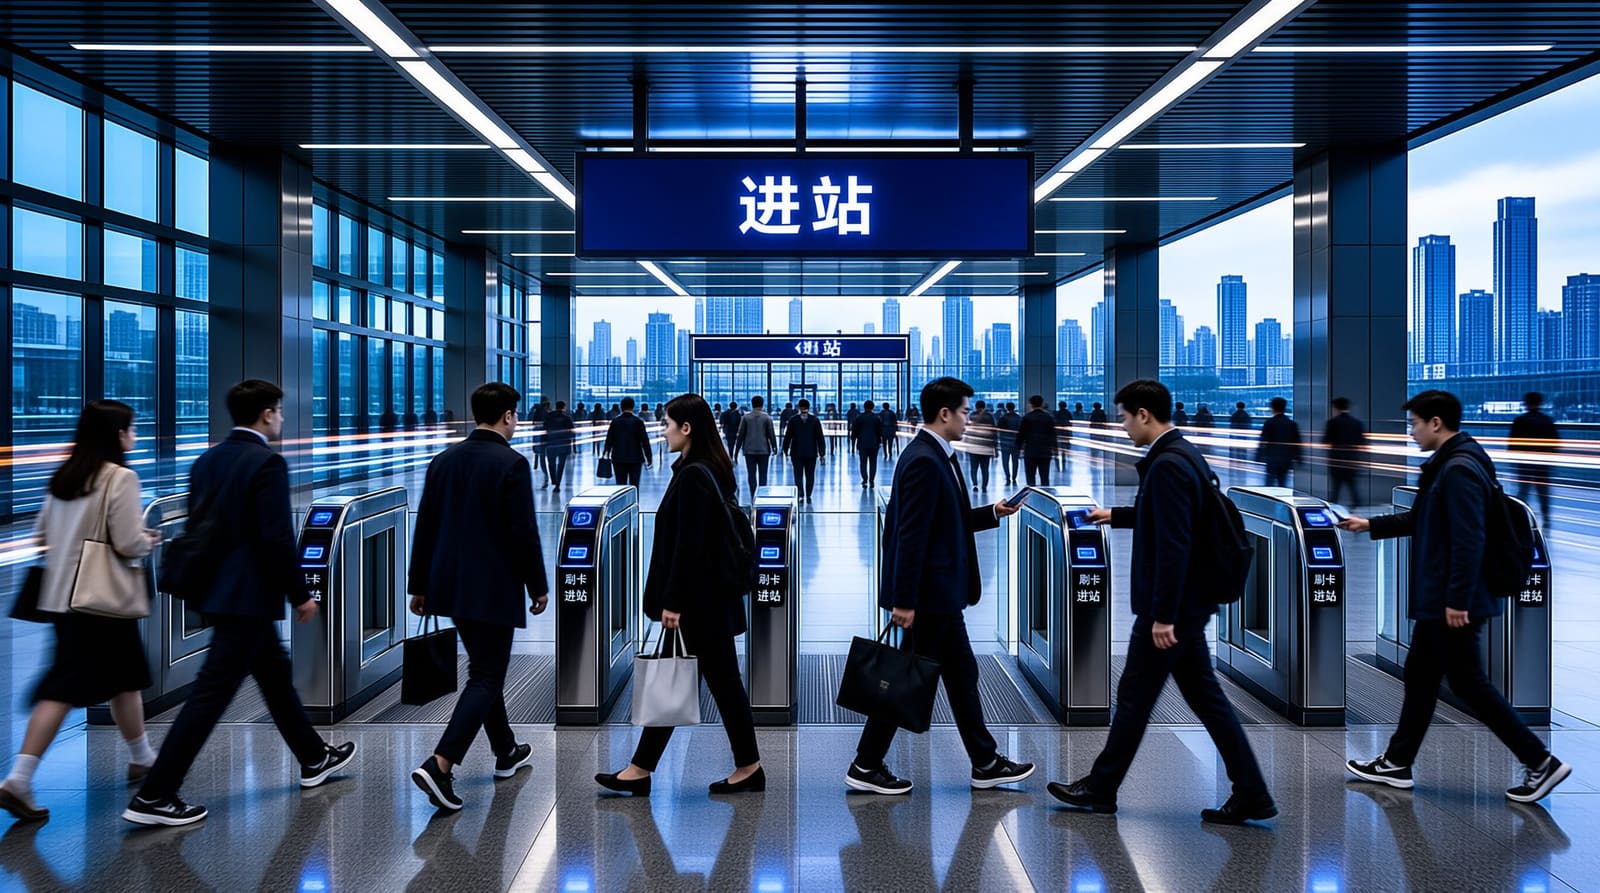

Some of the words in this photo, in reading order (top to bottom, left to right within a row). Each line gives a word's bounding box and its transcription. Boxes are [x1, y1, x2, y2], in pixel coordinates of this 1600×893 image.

[738, 175, 873, 235] 进站
[565, 573, 588, 586] 刷卡
[759, 573, 781, 586] 刷卡
[1079, 573, 1101, 586] 刷卡
[1313, 573, 1336, 586] 刷卡
[564, 589, 588, 602] 进站
[757, 589, 781, 602] 进站
[1076, 589, 1101, 602] 进站
[1313, 589, 1337, 602] 进站
[1520, 589, 1543, 602] 进站
